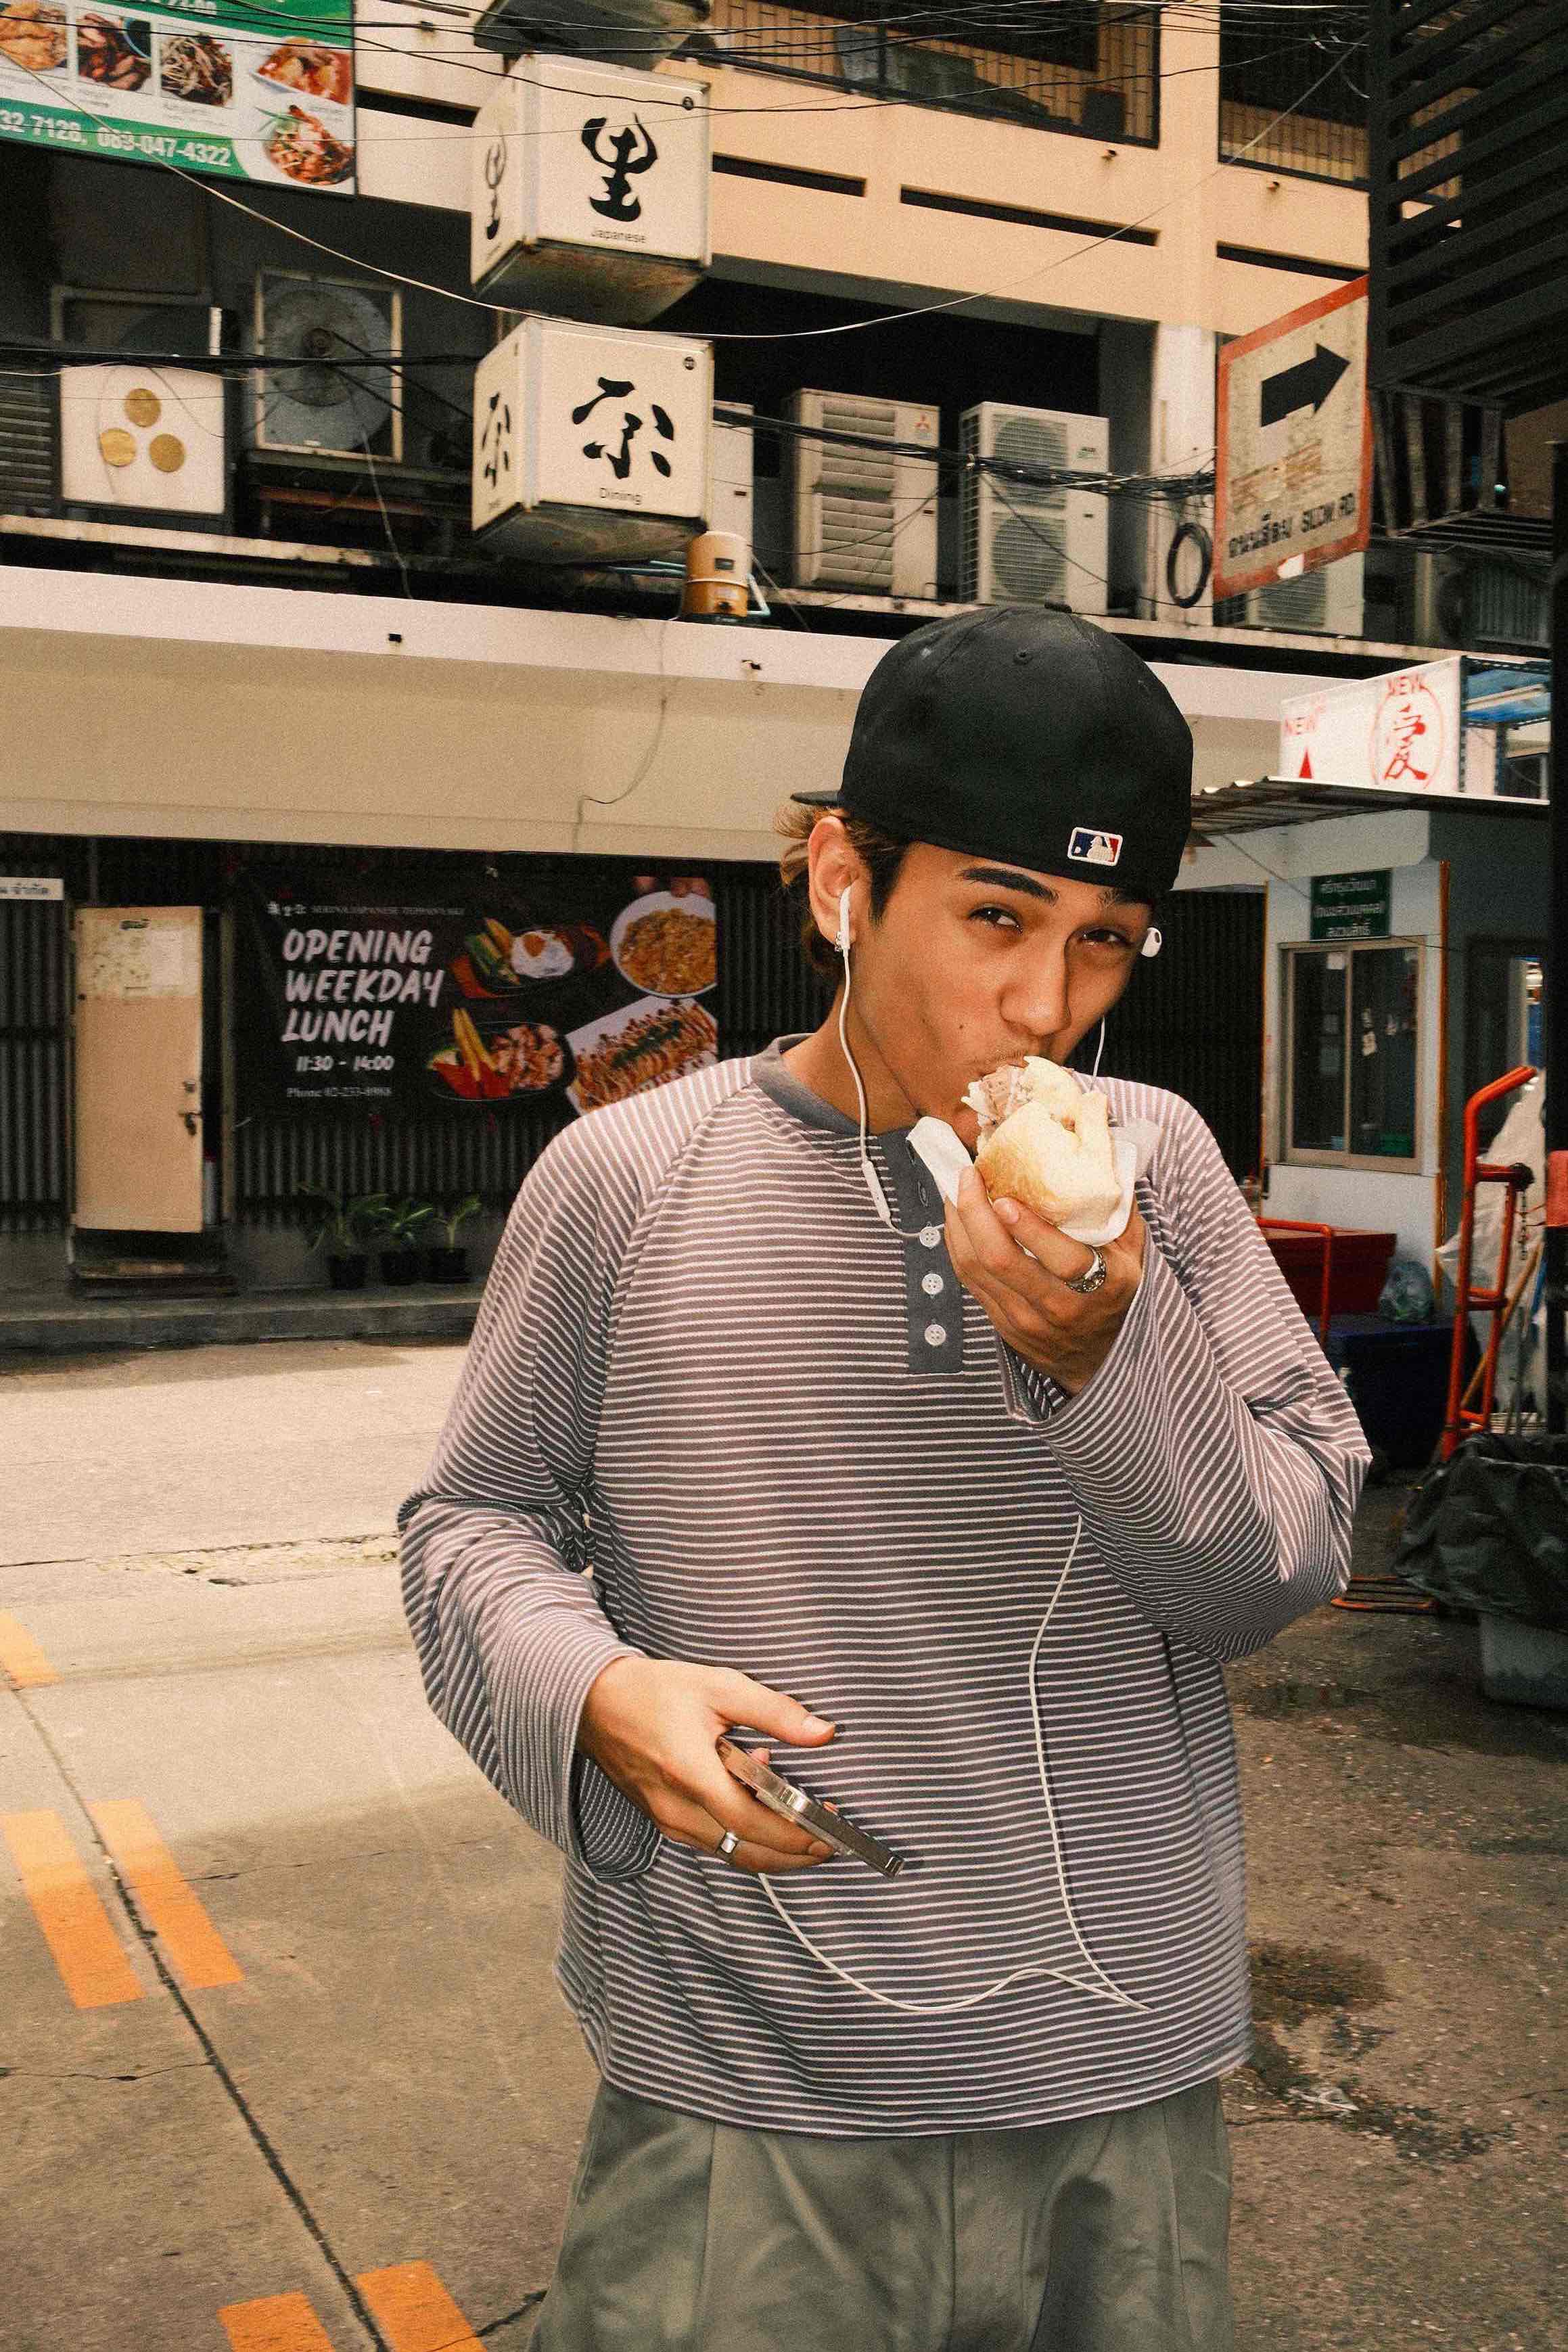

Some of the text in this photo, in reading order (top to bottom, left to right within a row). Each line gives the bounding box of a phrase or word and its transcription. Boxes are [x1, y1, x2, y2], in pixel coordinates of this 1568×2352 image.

[591, 229, 647, 244] Japanese
[599, 487, 643, 506] Dining
[282, 928, 434, 965] OPENING
[285, 968, 445, 1008] WEEKDAY
[281, 1008, 395, 1048] LUNCH
[296, 1055, 335, 1072] 11:30
[352, 1055, 395, 1072] 14:00
